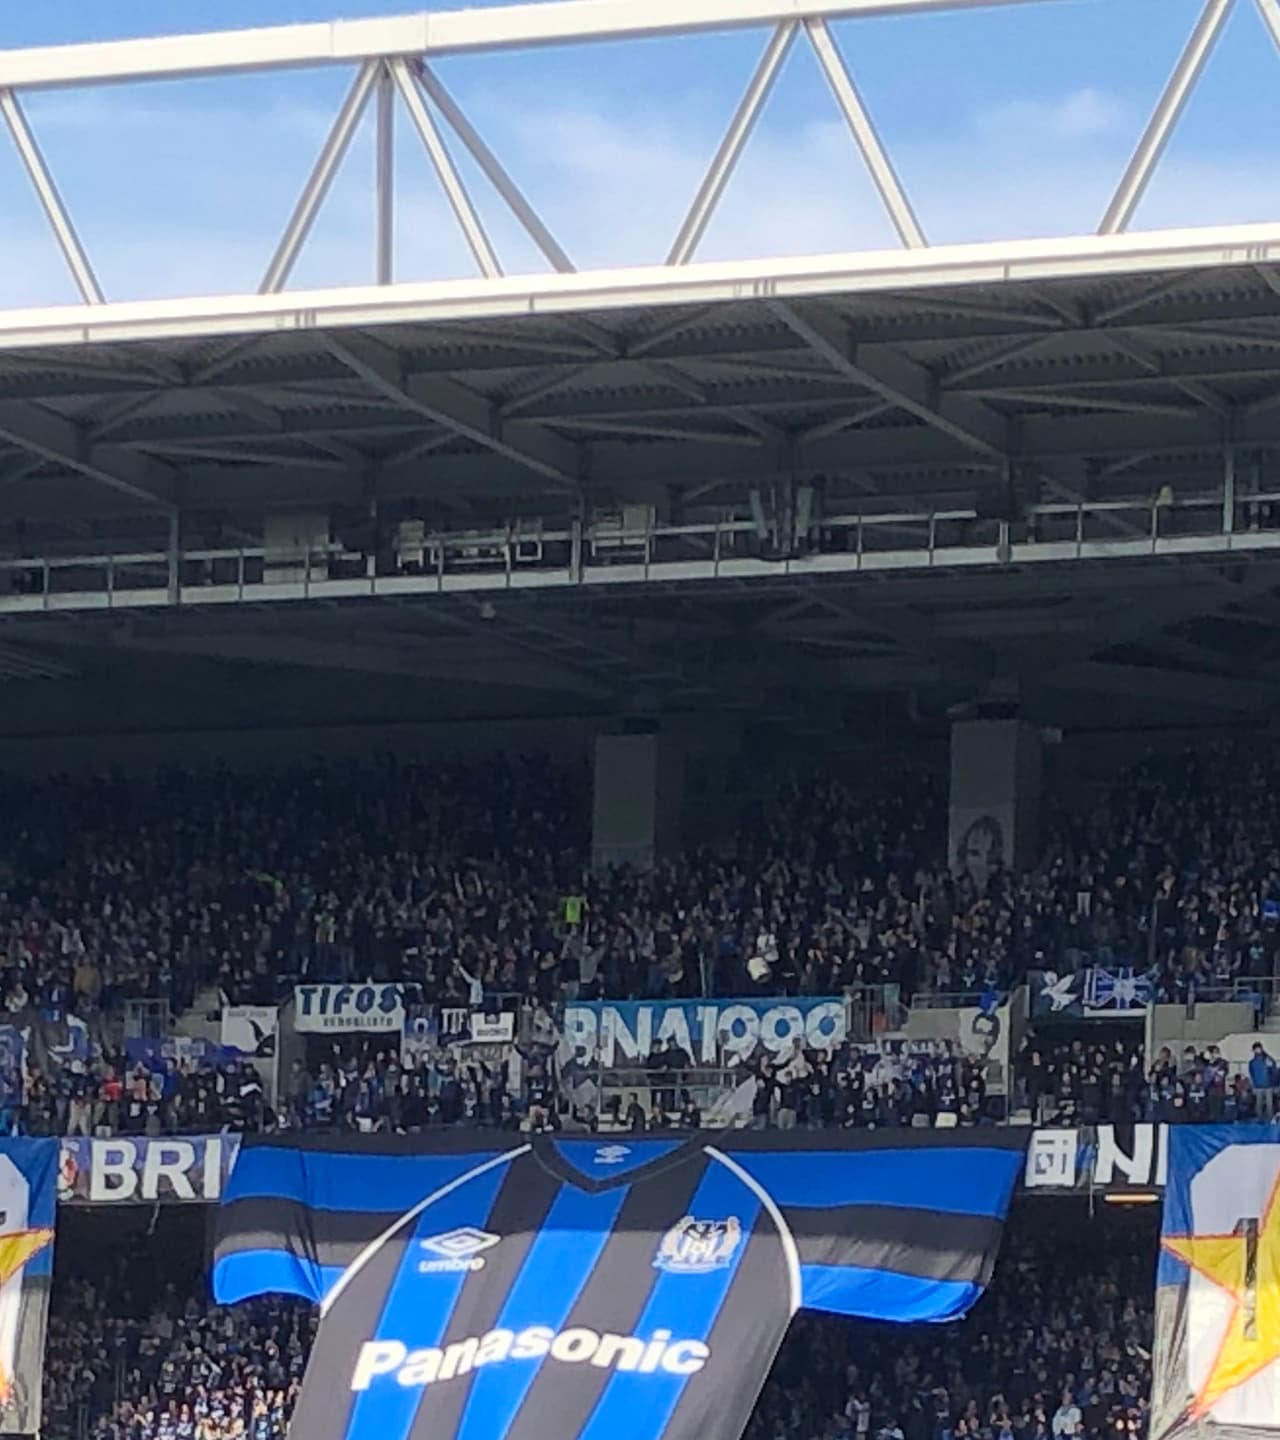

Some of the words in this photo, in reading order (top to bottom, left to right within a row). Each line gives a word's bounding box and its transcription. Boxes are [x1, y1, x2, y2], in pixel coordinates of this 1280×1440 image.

[300, 984, 404, 1016] TIFOS
[419, 1256, 486, 1274] umbro
[350, 1325, 711, 1392] Panasonic
